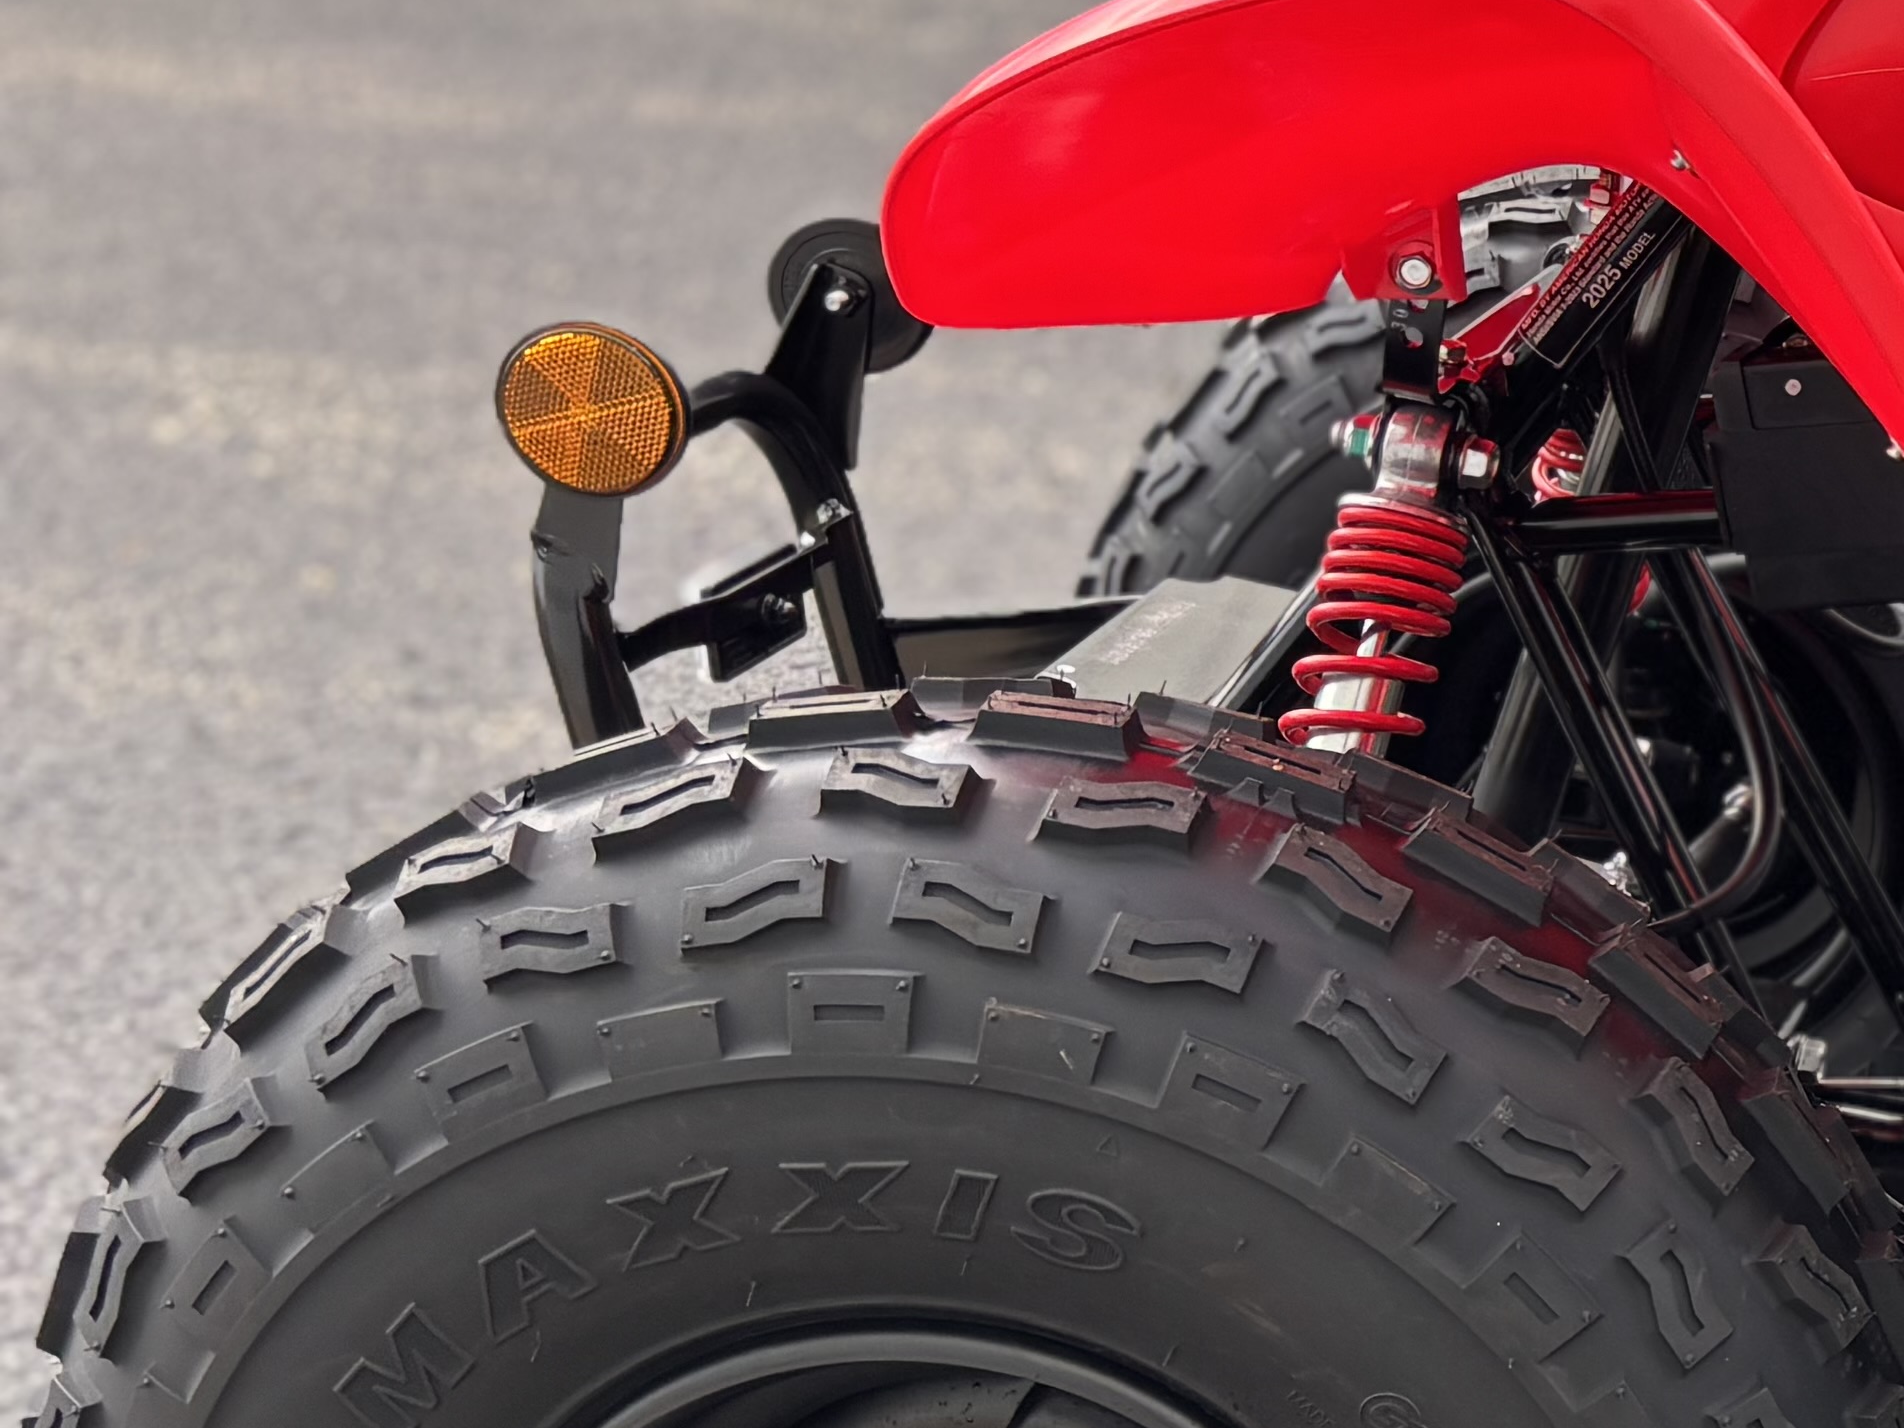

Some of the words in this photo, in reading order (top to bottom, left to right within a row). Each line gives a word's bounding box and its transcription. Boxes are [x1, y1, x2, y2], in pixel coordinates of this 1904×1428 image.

[1549, 245, 1591, 296] AMERICAN
[1587, 214, 1615, 249] HONDA
[1580, 262, 1623, 310] 2025
[1618, 227, 1656, 271] MODEL
